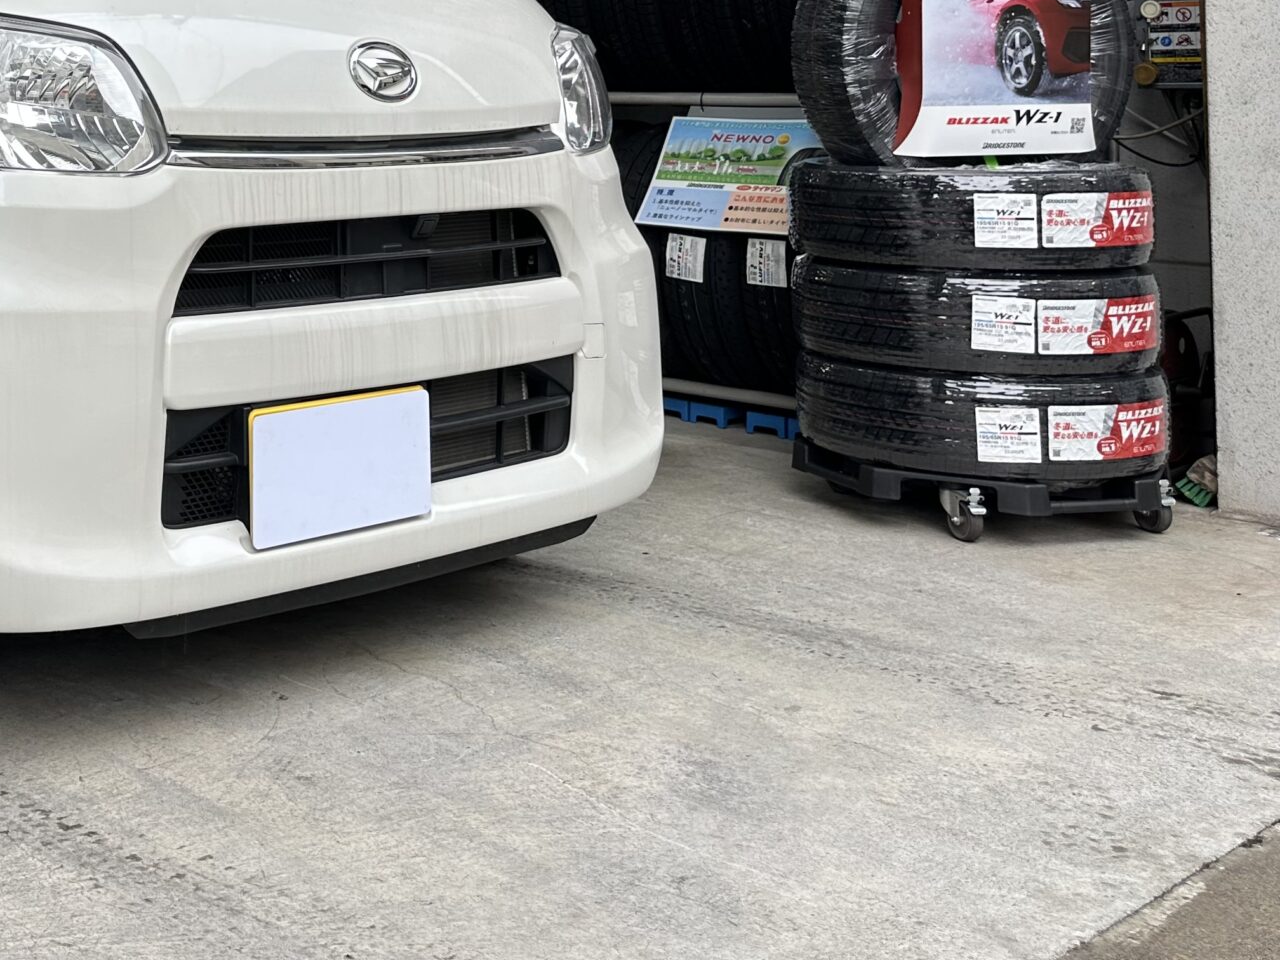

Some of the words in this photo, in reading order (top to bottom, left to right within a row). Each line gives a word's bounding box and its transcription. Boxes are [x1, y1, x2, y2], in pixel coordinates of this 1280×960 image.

[946, 116, 1011, 126] BLIZZAK
[1014, 109, 1062, 126] WZ-1
[711, 133, 775, 144] NEWNO
[982, 141, 1026, 149] BRIDGESTONE
[1110, 209, 1148, 232] WZ-1
[1107, 301, 1155, 315] BLIZZAK
[1109, 315, 1152, 339] WZ-1
[1117, 405, 1163, 420] BLIZZAK
[1120, 419, 1160, 444] WZ-1
